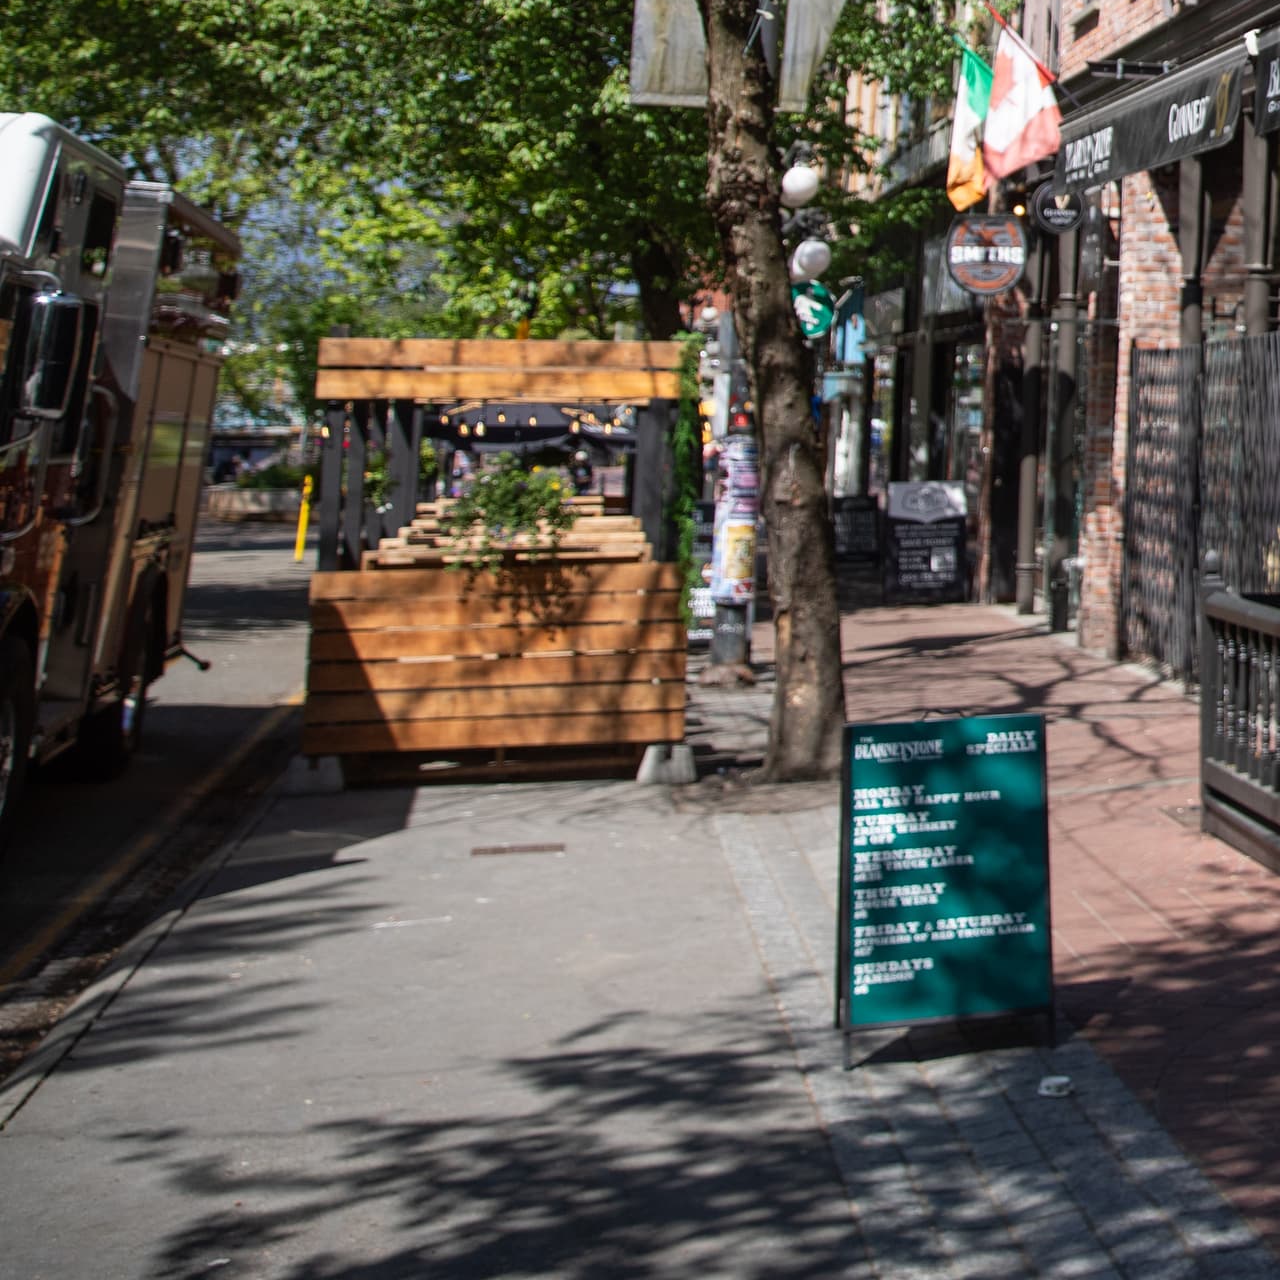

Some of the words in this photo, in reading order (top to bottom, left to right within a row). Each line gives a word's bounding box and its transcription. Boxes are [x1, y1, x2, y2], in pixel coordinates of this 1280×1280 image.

[986, 731, 1036, 742] DAILY
[966, 741, 1036, 755] SPECIALS
[853, 785, 925, 800] MONDAY
[914, 792, 961, 805] HAPPY
[964, 790, 1001, 802] HOUR
[853, 811, 930, 827] TUESDAY
[854, 845, 957, 863] WEDNESDAY
[854, 882, 946, 900] THURSDAY
[854, 921, 920, 938] FRIDAY
[936, 913, 1025, 931] SATURDAY
[854, 957, 934, 977] SUNDAYS
